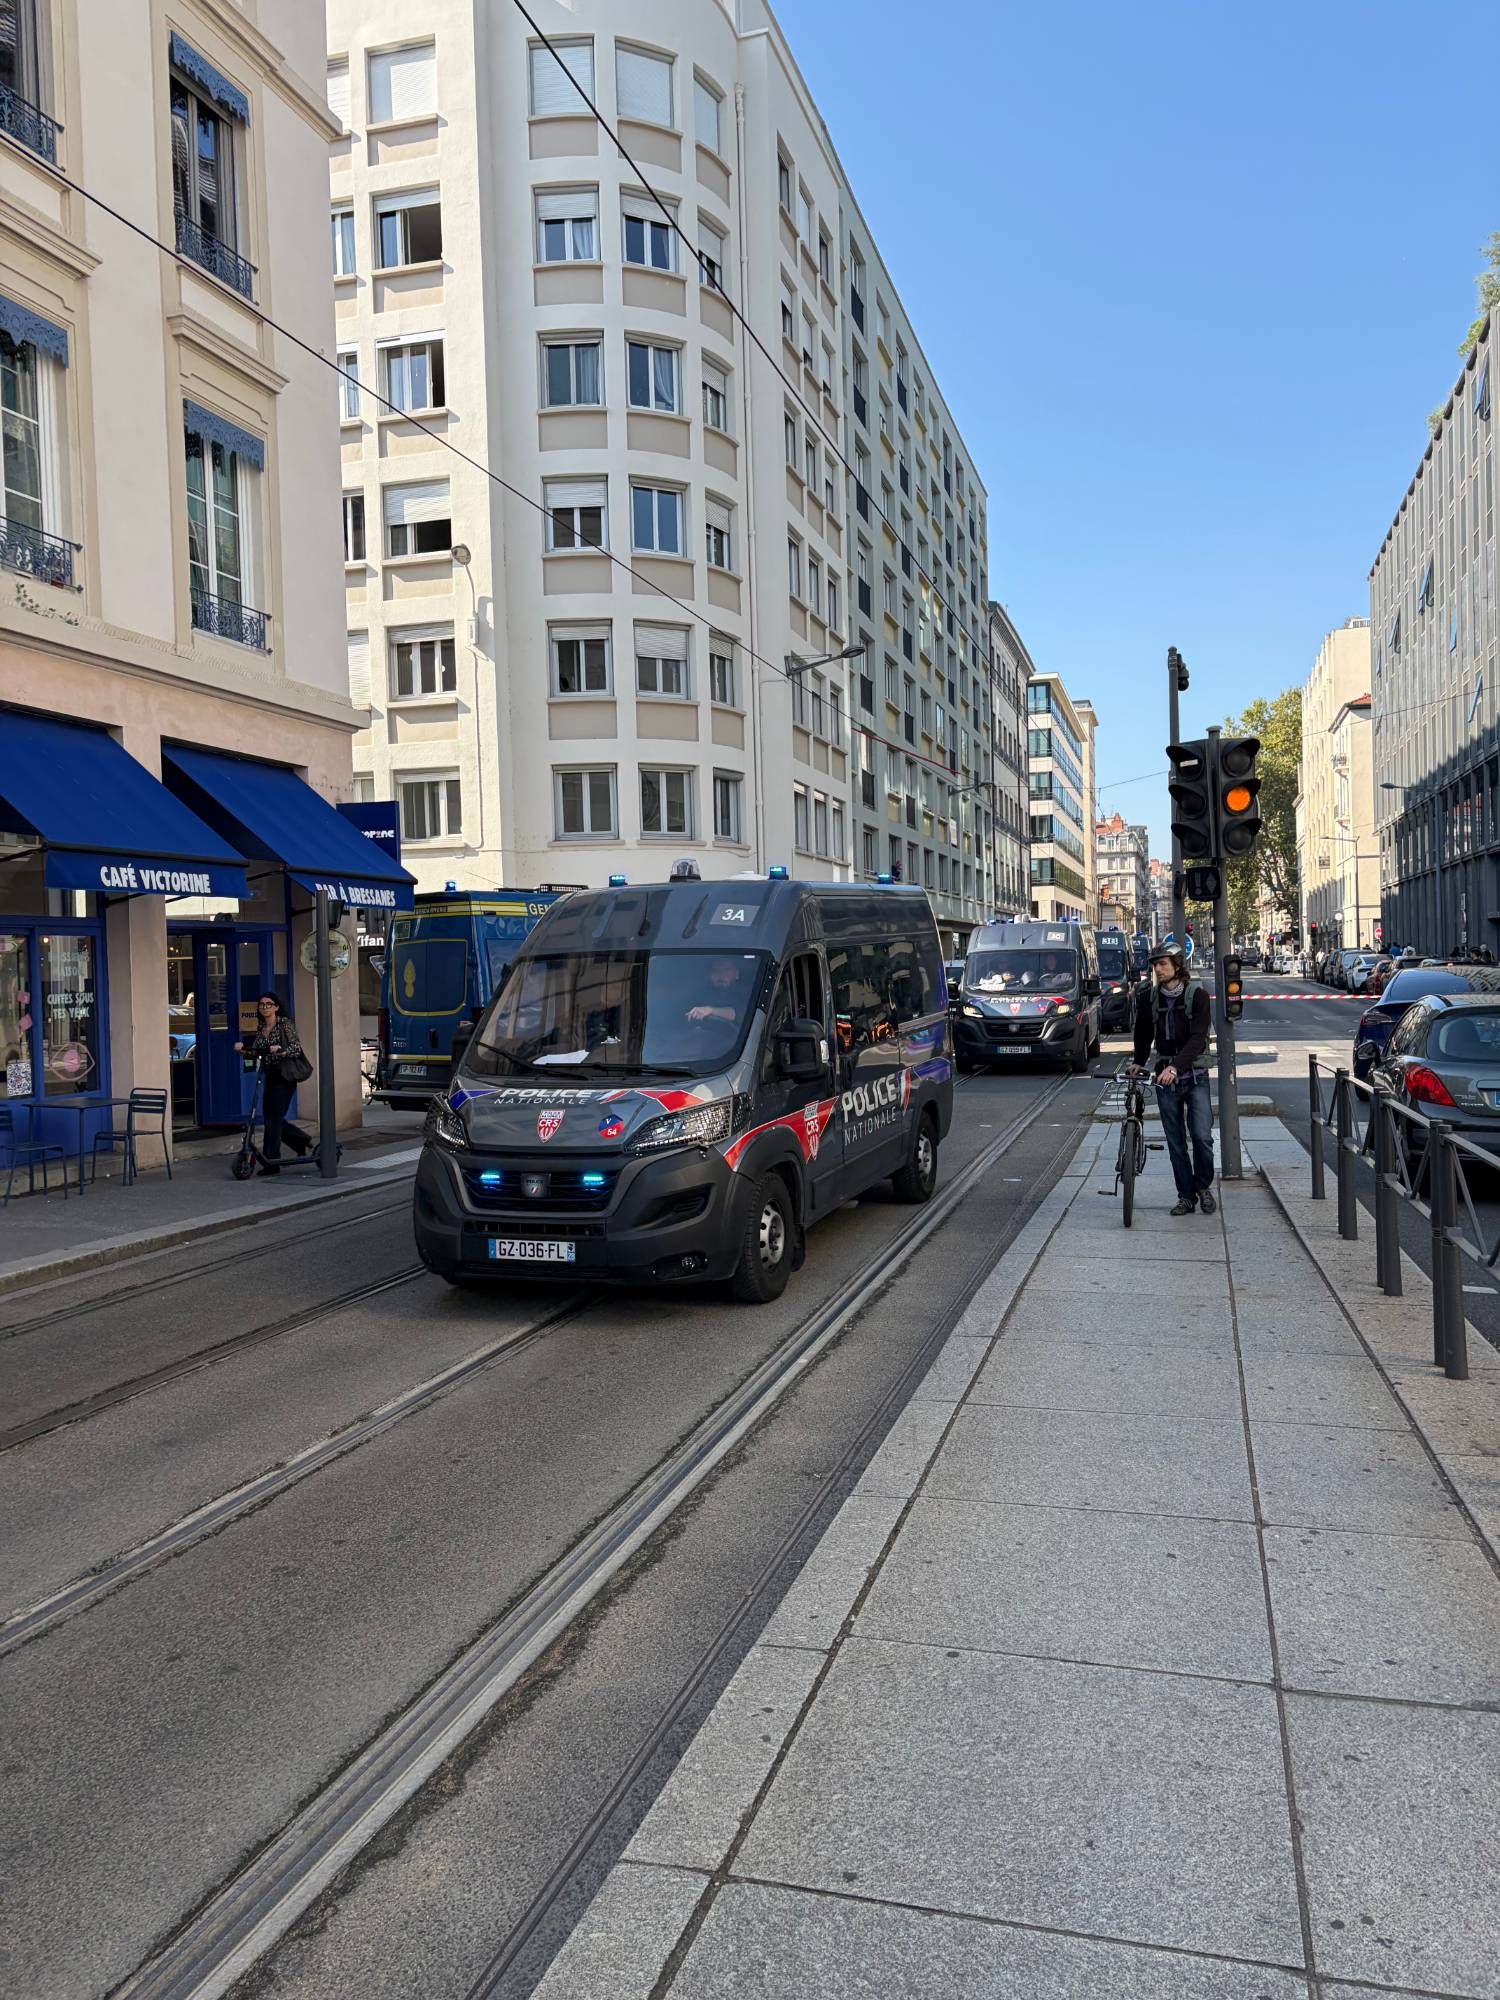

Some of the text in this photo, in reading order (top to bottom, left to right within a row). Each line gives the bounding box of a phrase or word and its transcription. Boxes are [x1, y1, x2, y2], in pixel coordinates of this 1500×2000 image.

[100, 863, 211, 893] CAFÉ VICTORINE
[347, 886, 396, 907] BRESSANES
[721, 909, 745, 921] 3A
[500, 1089, 595, 1098] POLICE
[842, 1073, 899, 1123] POLICE
[539, 1119, 559, 1128] CRS
[806, 1119, 819, 1135] CRS
[844, 1106, 896, 1146] NATIONALE
[607, 1128, 617, 1136] 54
